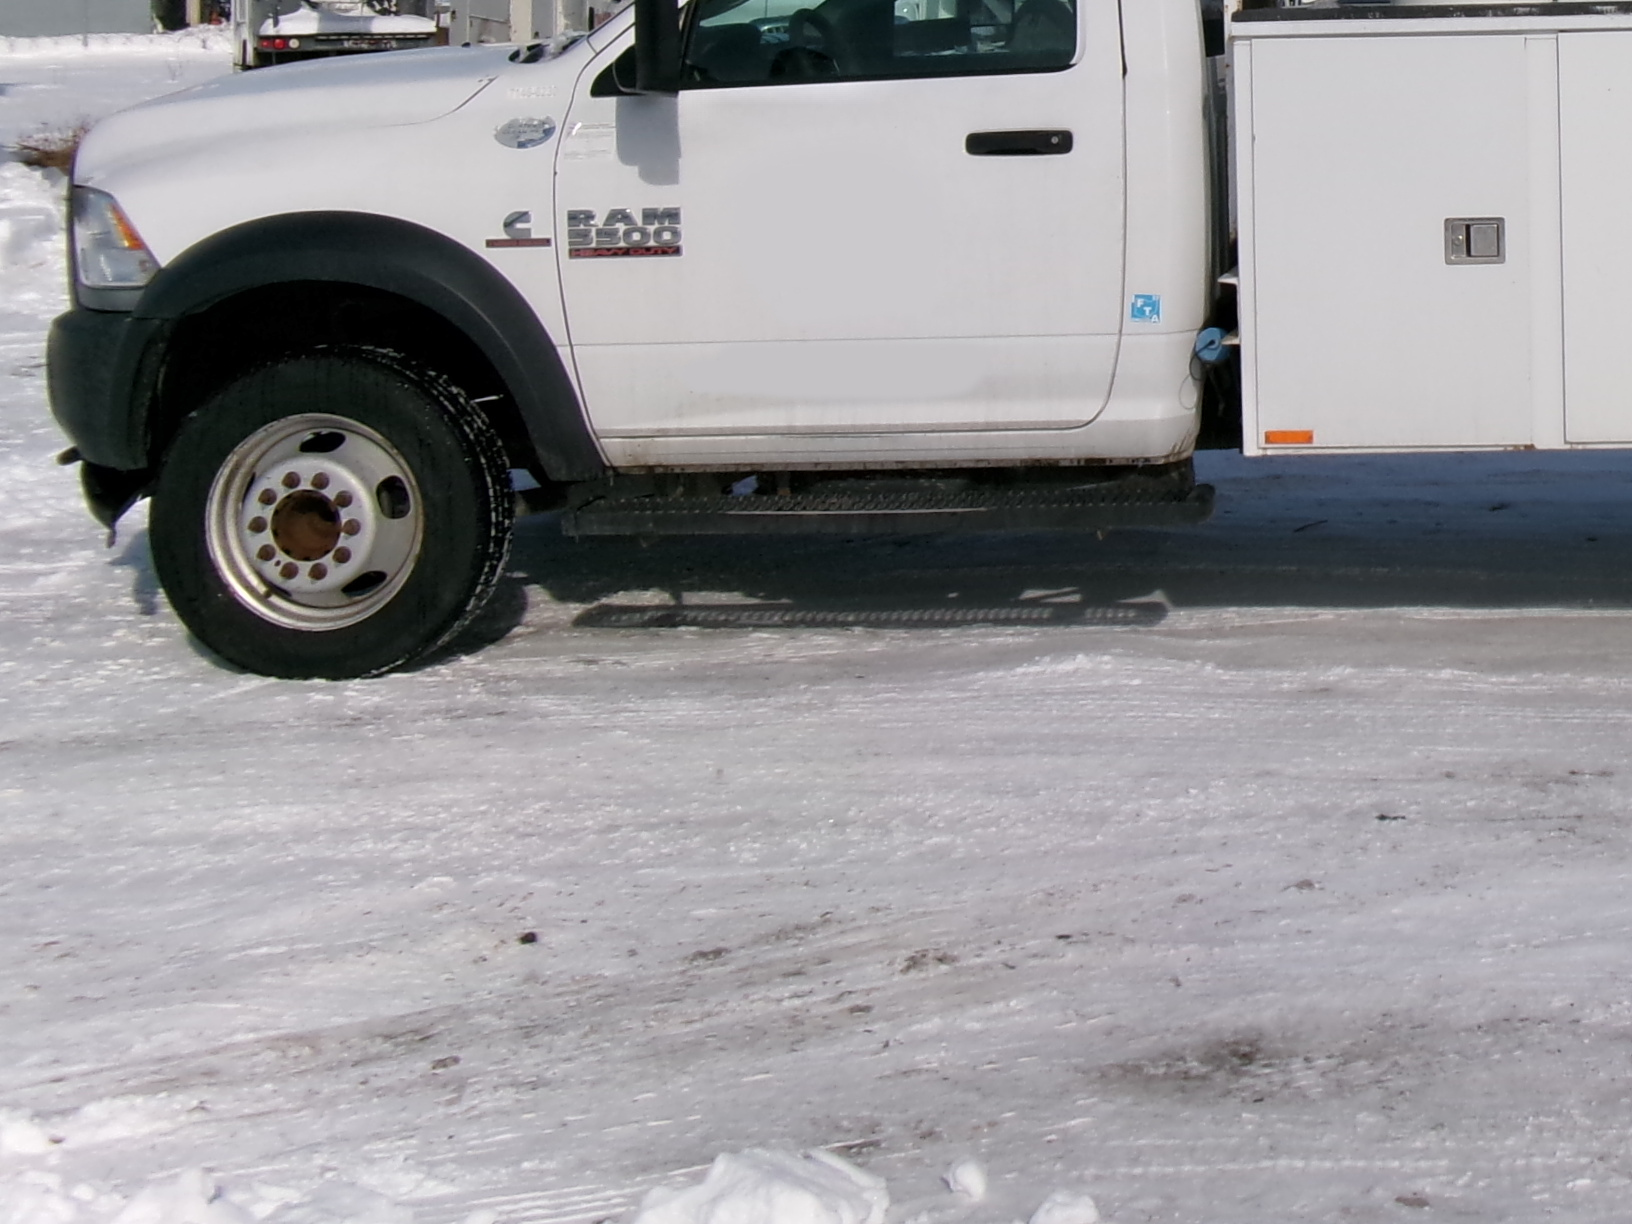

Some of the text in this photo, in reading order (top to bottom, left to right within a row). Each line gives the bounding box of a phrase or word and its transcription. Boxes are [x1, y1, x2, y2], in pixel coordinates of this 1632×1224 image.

[567, 207, 681, 227] RAM
[568, 226, 682, 246] 5500
[571, 247, 678, 258] HEAVY DUTY
